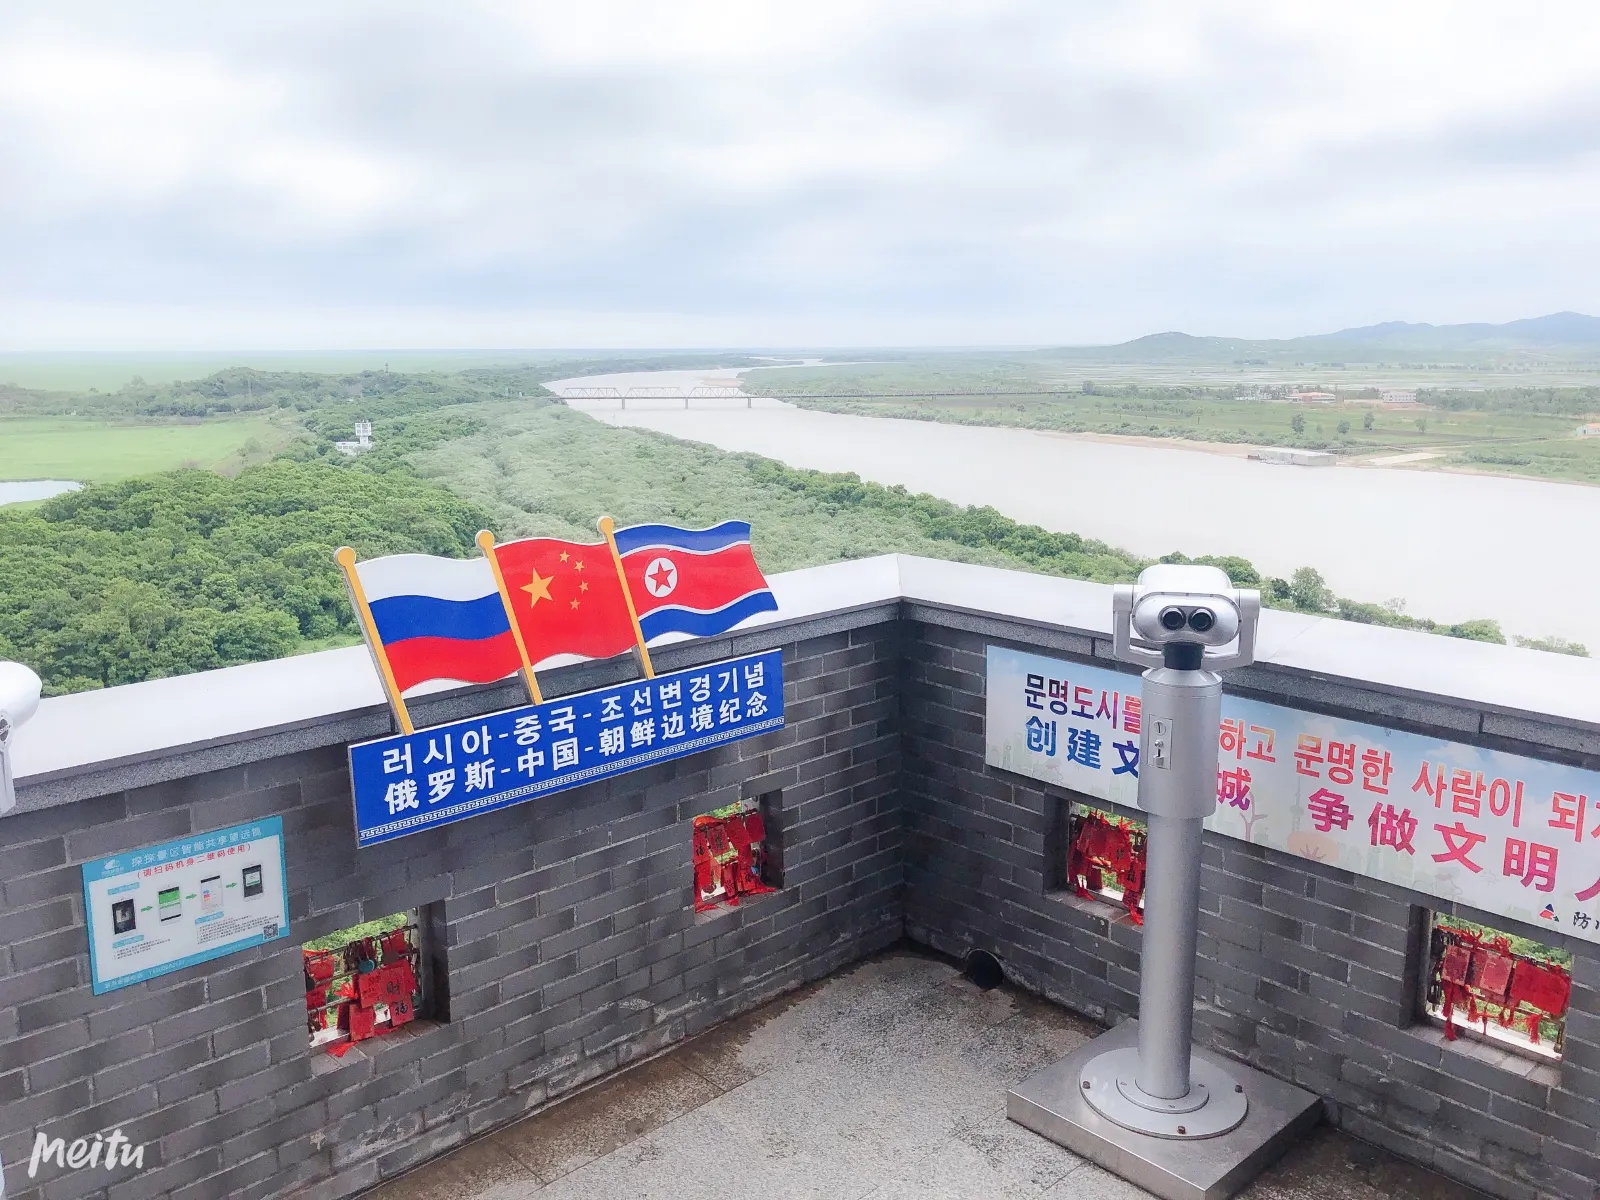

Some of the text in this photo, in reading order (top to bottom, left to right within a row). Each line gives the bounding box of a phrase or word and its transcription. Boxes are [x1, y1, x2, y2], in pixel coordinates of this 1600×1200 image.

[1025, 673, 1141, 734] 문명도시를
[1293, 734, 1393, 795] 문명한
[1411, 761, 1524, 828] 사람이
[1572, 911, 1600, 931] 防
